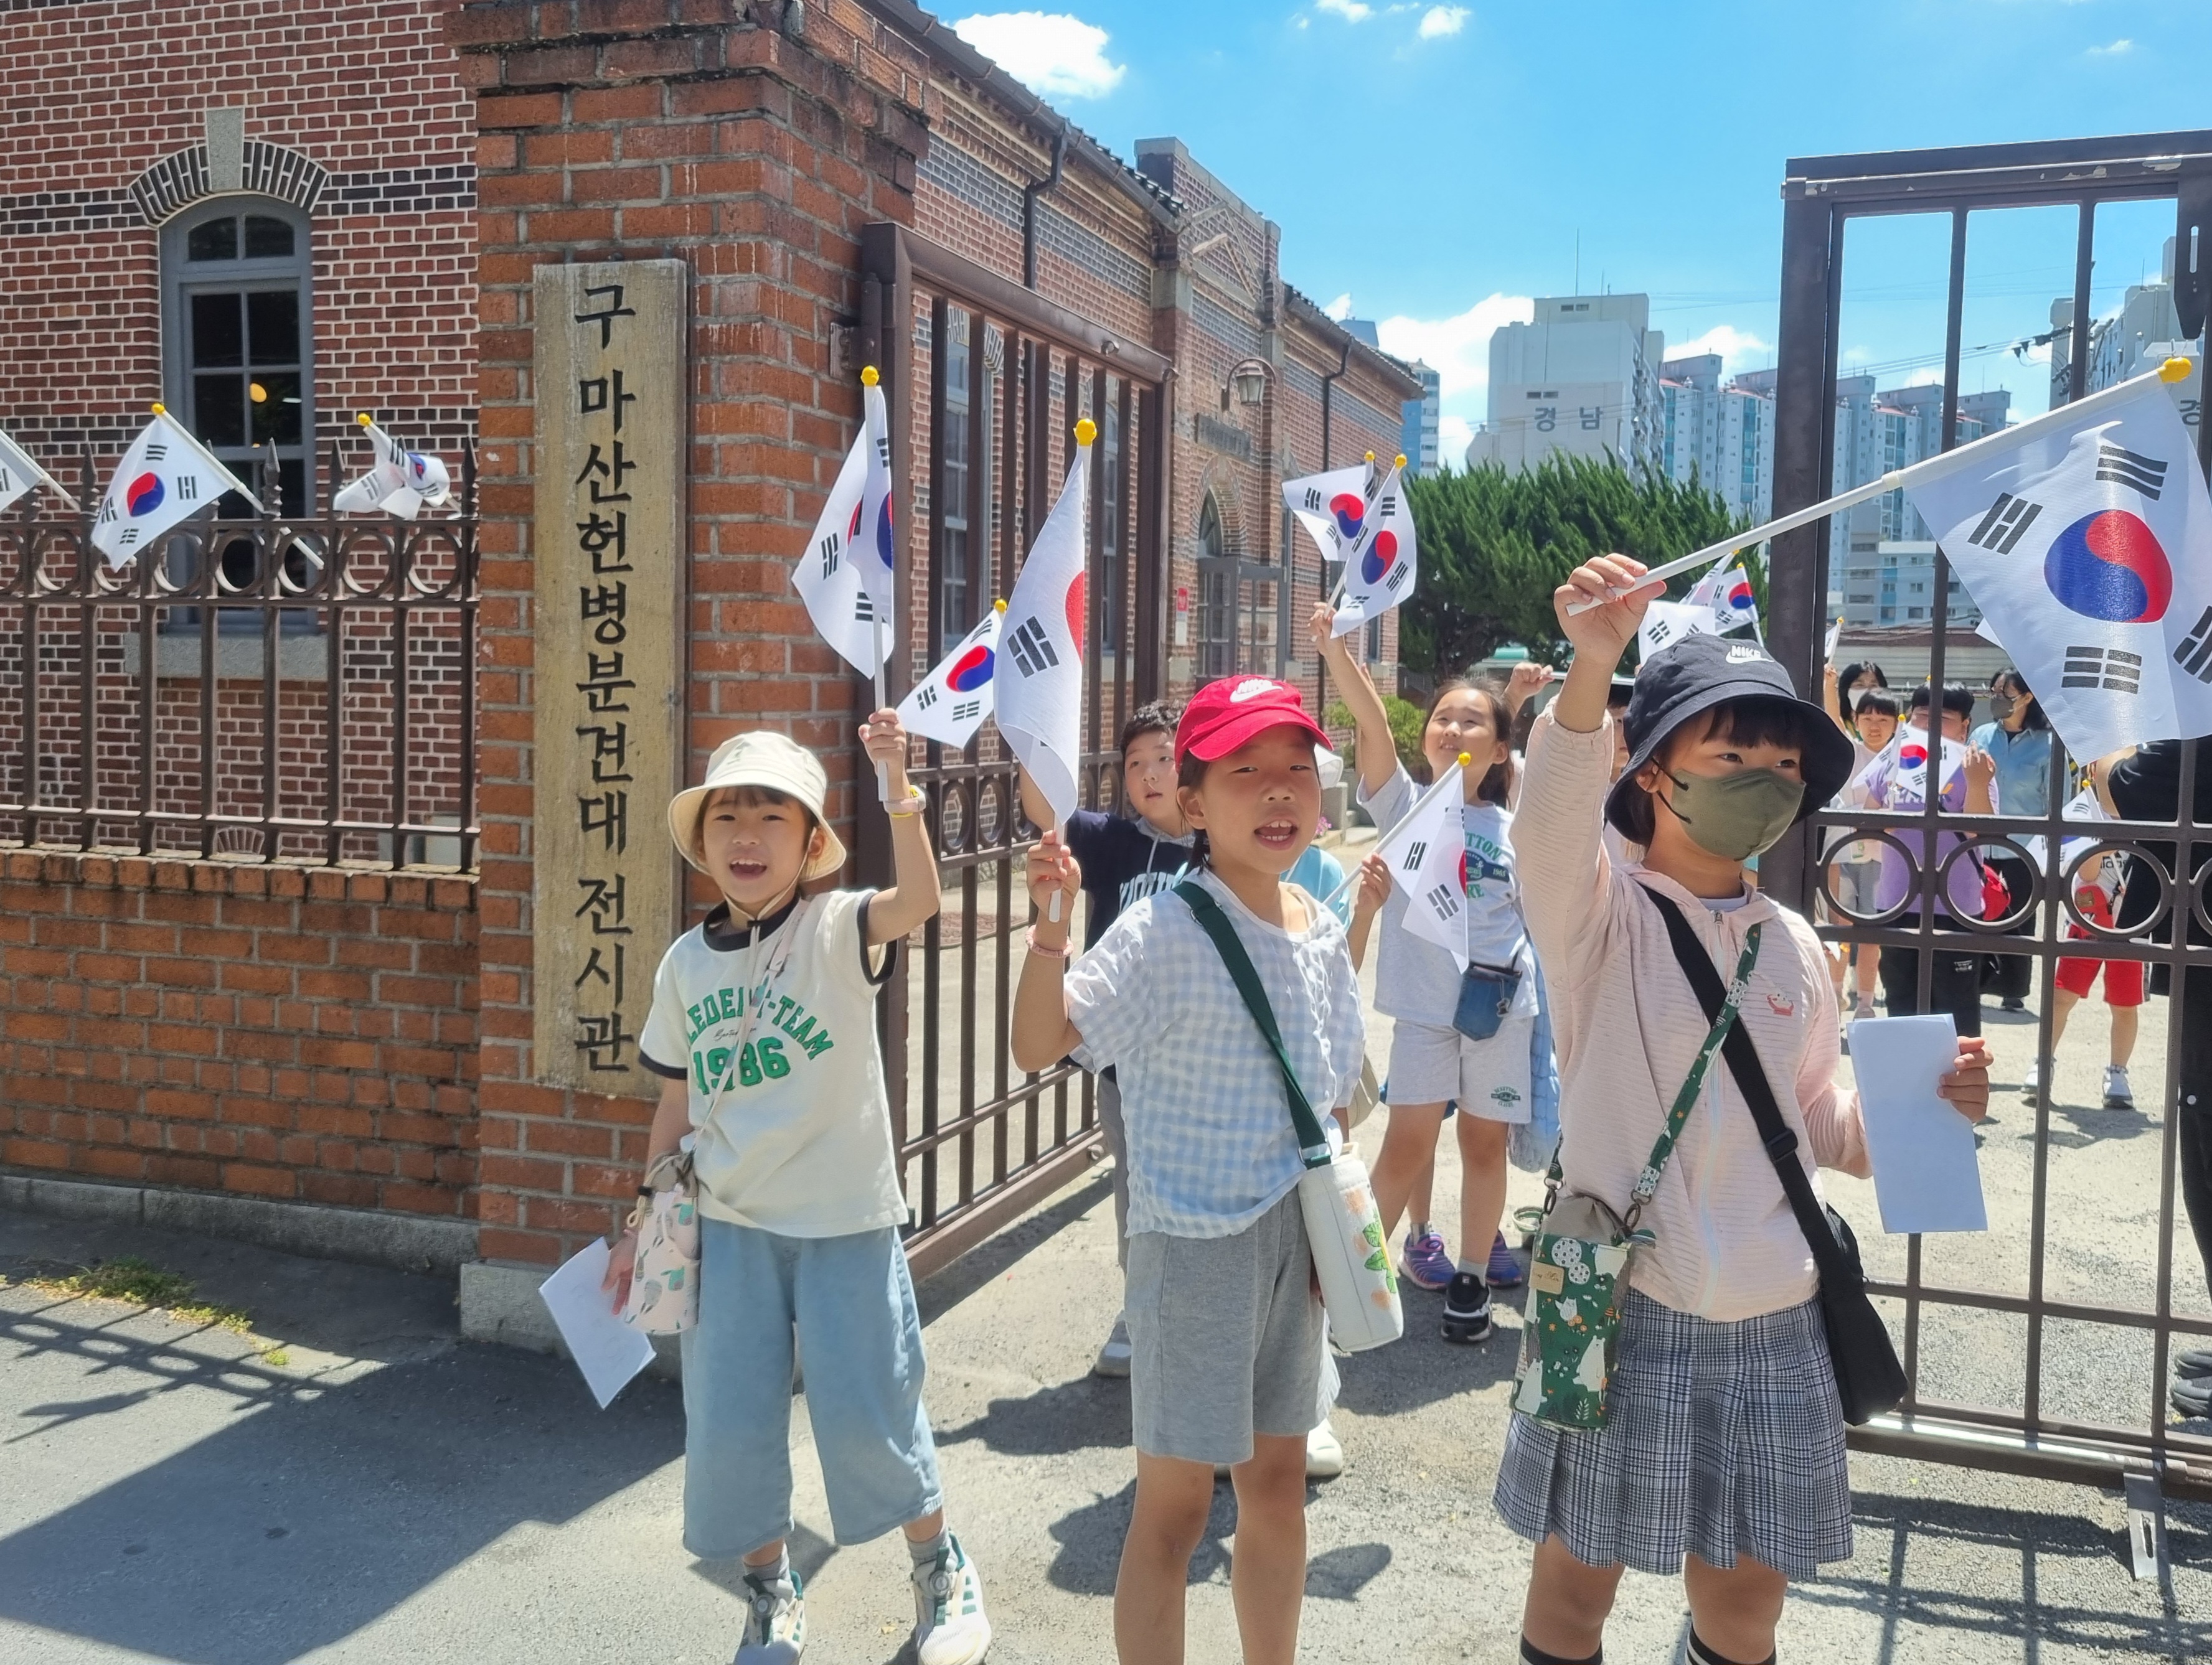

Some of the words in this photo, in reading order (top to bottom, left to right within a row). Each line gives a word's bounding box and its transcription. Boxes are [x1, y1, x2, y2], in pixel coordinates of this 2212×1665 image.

[1731, 645, 1761, 658] NIKE
[1236, 678, 1273, 695] NIKE
[574, 873, 635, 1072] 전시관
[693, 1036, 791, 1095] 1986
